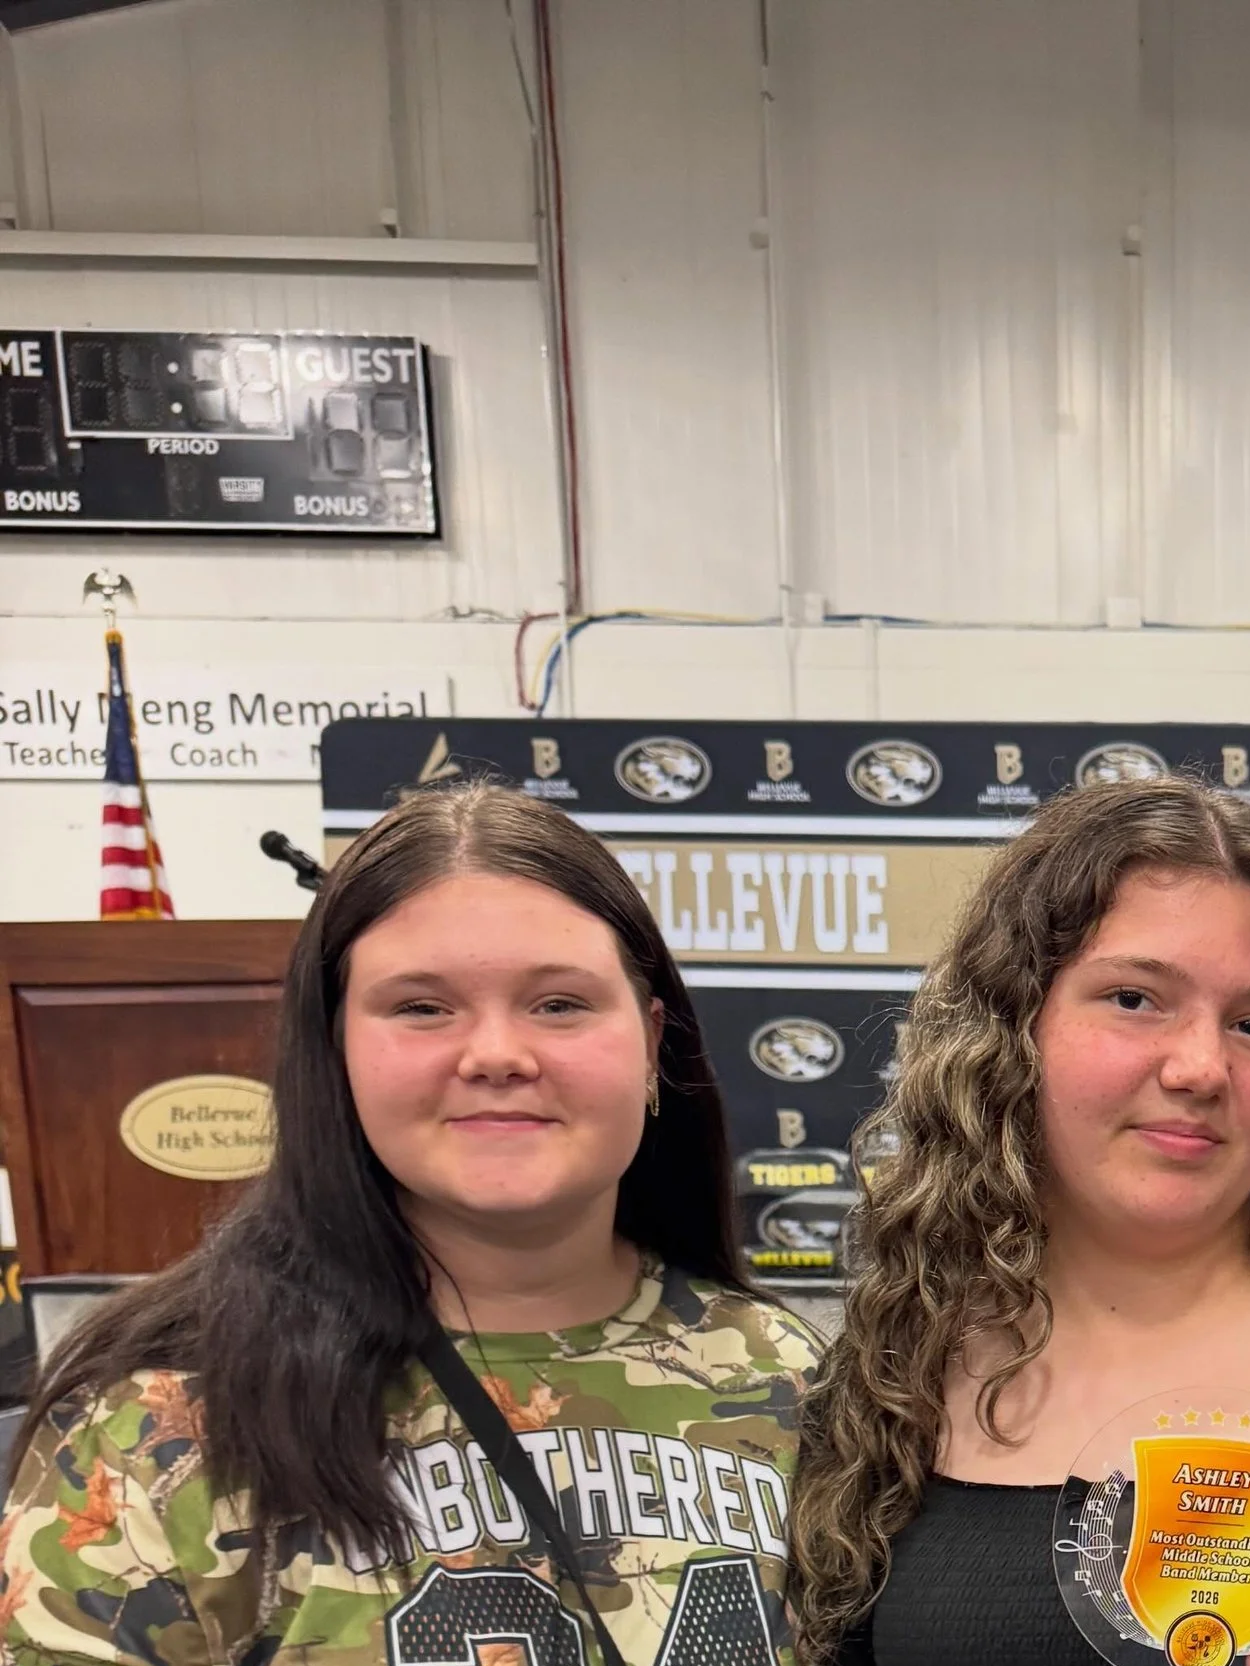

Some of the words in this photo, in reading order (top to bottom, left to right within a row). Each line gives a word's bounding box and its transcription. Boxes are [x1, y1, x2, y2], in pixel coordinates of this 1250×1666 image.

[299, 348, 414, 384] GUEST
[147, 438, 220, 456] PERIOD
[4, 490, 81, 512] BONUS
[294, 495, 369, 517] BONUS
[229, 692, 427, 727] Memorial
[4, 741, 107, 766] Teache
[170, 742, 258, 767] Coach
[531, 737, 561, 778] B
[764, 741, 794, 782] B
[994, 744, 1024, 785] B
[1221, 747, 1249, 788] B
[616, 849, 889, 954] LLEVUE
[171, 1104, 257, 1124] Bellevue
[156, 1131, 204, 1152] High
[209, 1130, 275, 1149] Schoo
[777, 1108, 806, 1149] B
[748, 1163, 836, 1187] TIGERS
[342, 1426, 790, 1576] NBOTHERED
[1178, 1490, 1249, 1516] SMITH
[1150, 1530, 1185, 1546] Most
[1161, 1548, 1208, 1564] Middle
[1160, 1565, 1197, 1580] Band
[1191, 1590, 1219, 1605] 2026
